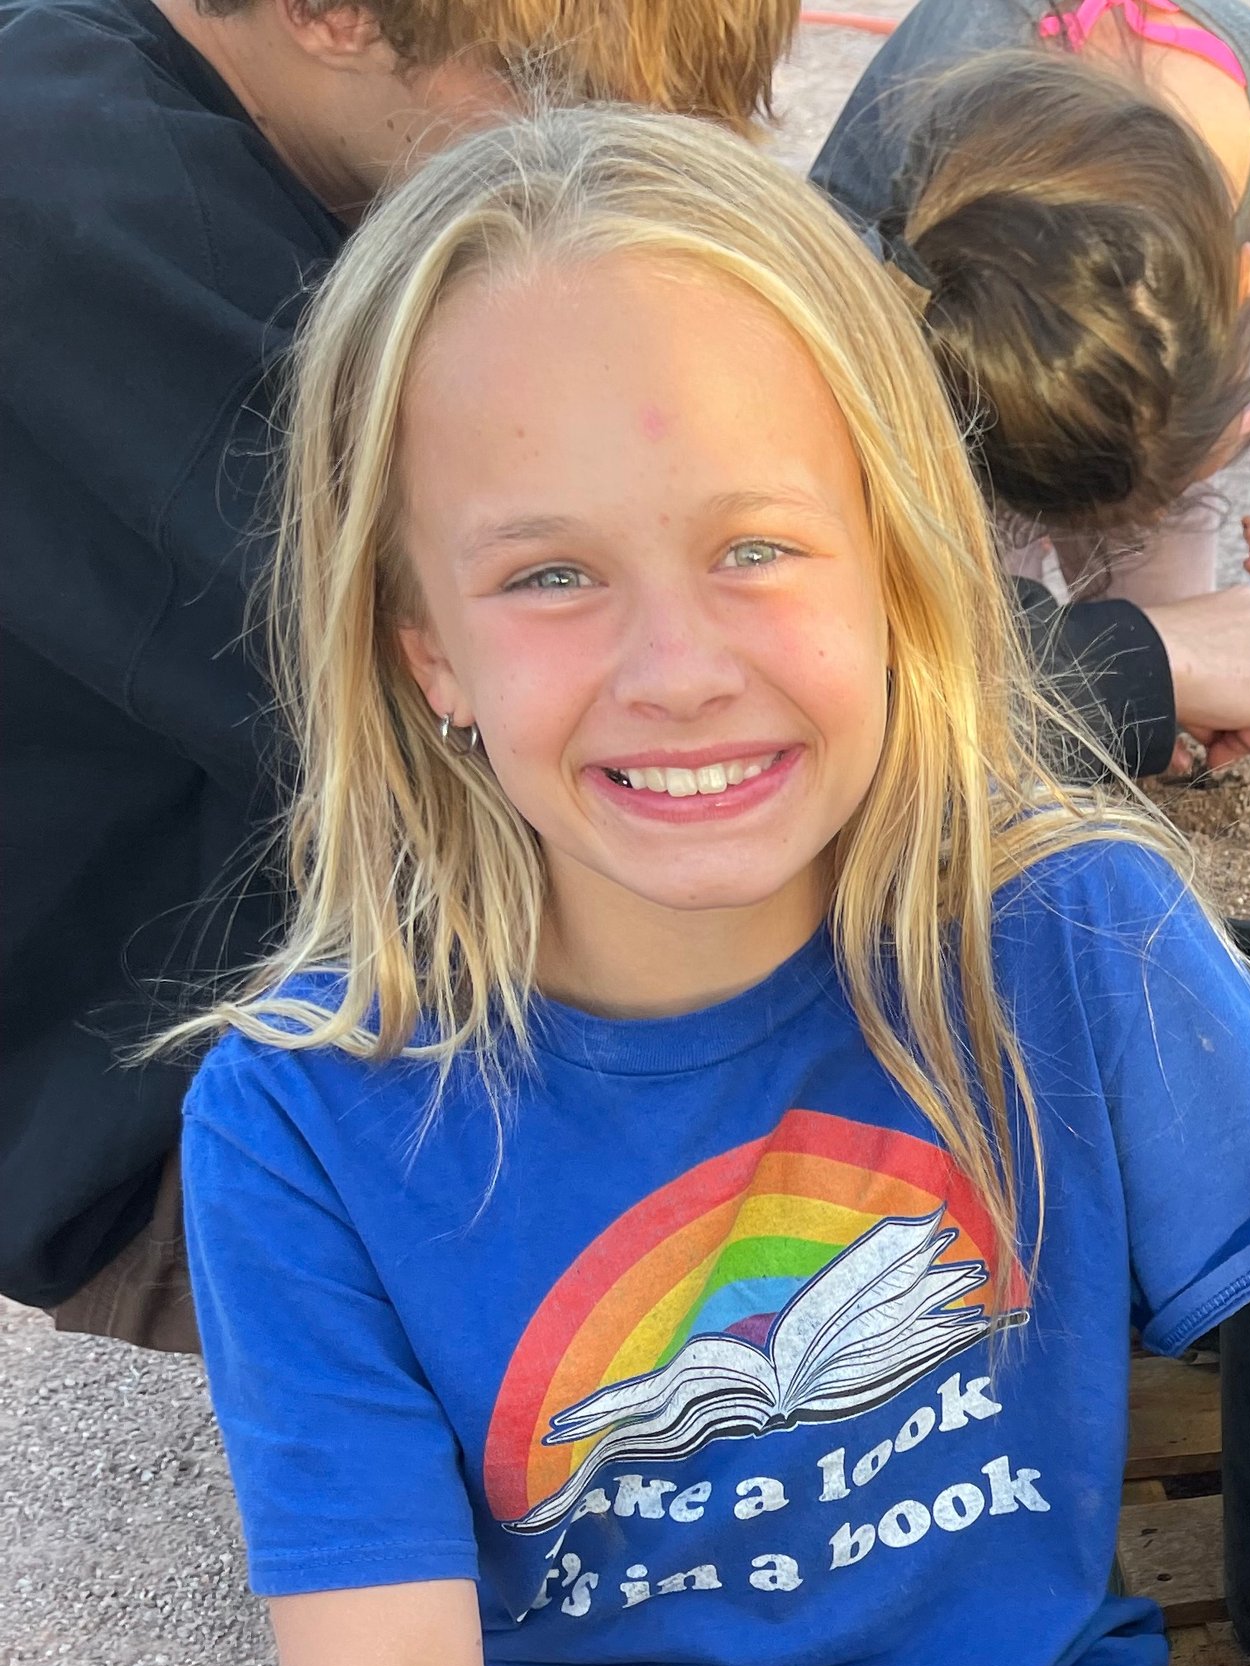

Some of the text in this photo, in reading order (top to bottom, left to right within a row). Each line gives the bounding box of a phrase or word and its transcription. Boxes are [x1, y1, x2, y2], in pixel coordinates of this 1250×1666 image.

[570, 1372, 1003, 1523] ake a look
[517, 1455, 1051, 1617] t's in a book
